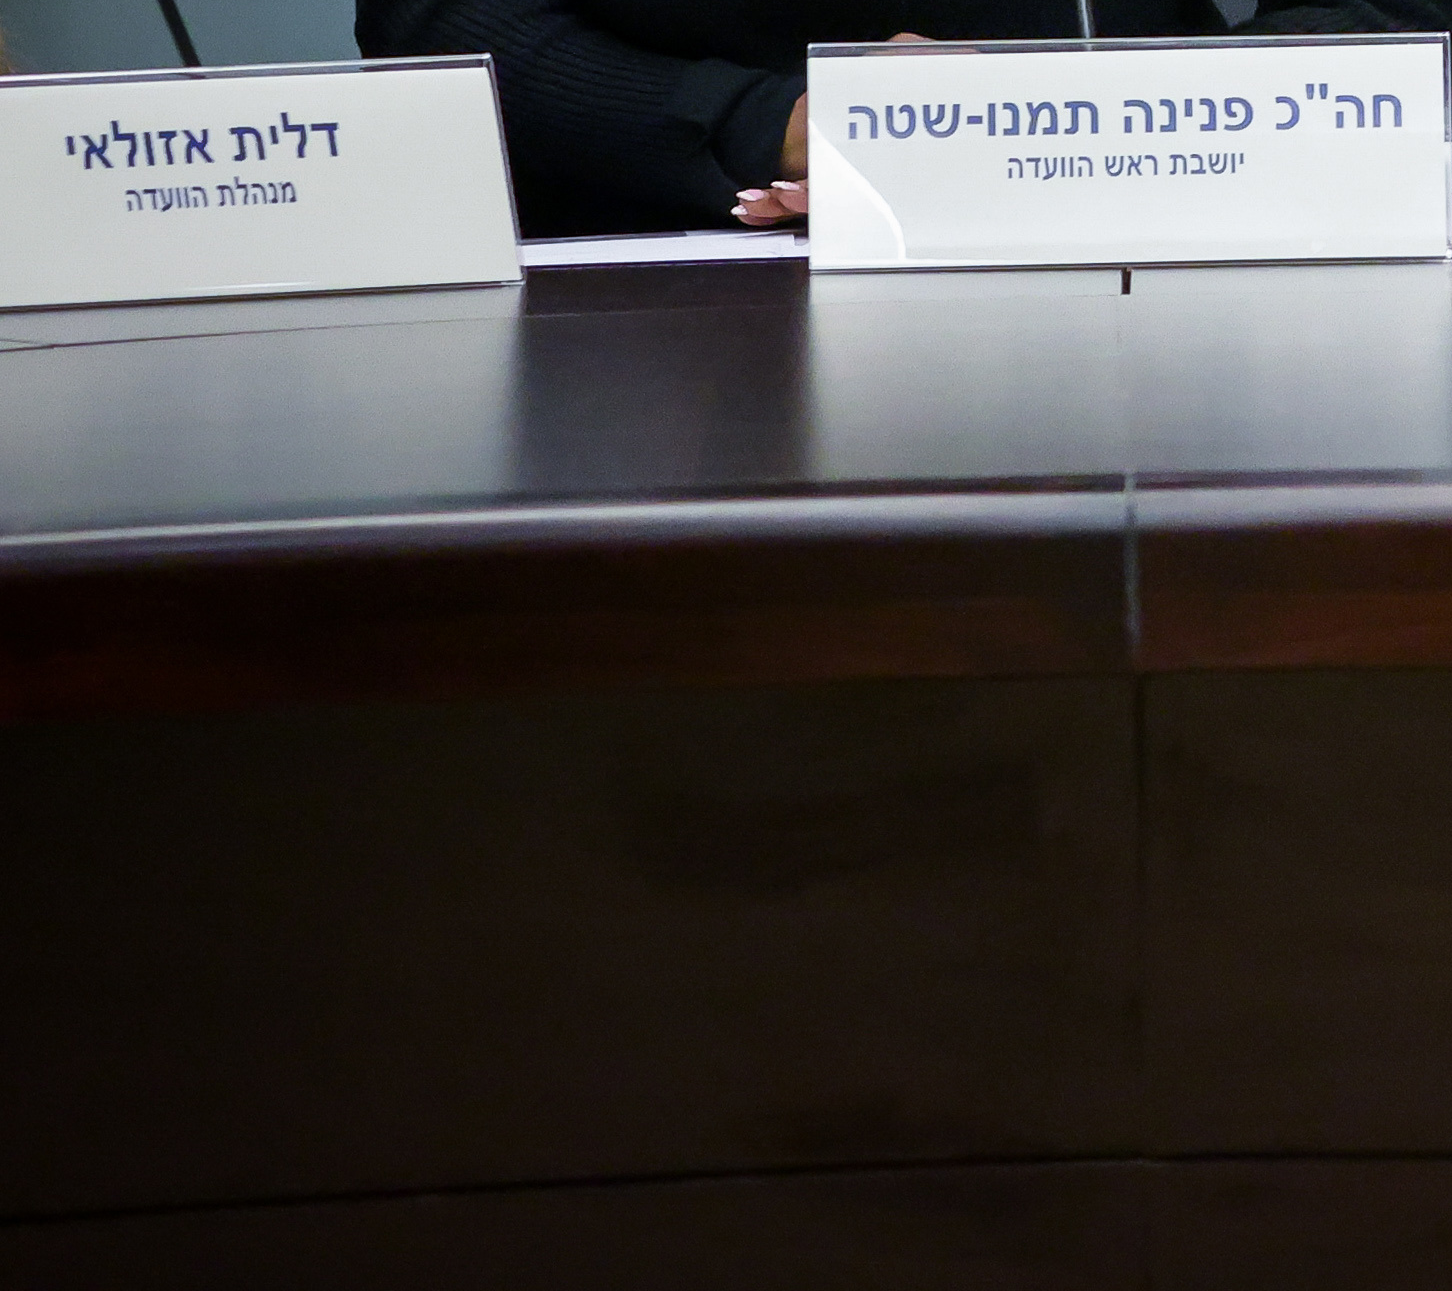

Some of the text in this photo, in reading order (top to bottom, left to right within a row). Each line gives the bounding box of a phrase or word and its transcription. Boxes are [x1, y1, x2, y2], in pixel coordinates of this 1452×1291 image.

[848, 83, 1403, 140] חה"כ פנינה תמנו-שטה
[65, 112, 339, 170] דלית אזולאי
[1007, 152, 1245, 181] יושבת ראש הוועדה
[125, 176, 297, 212] מנהלת הוועדה
